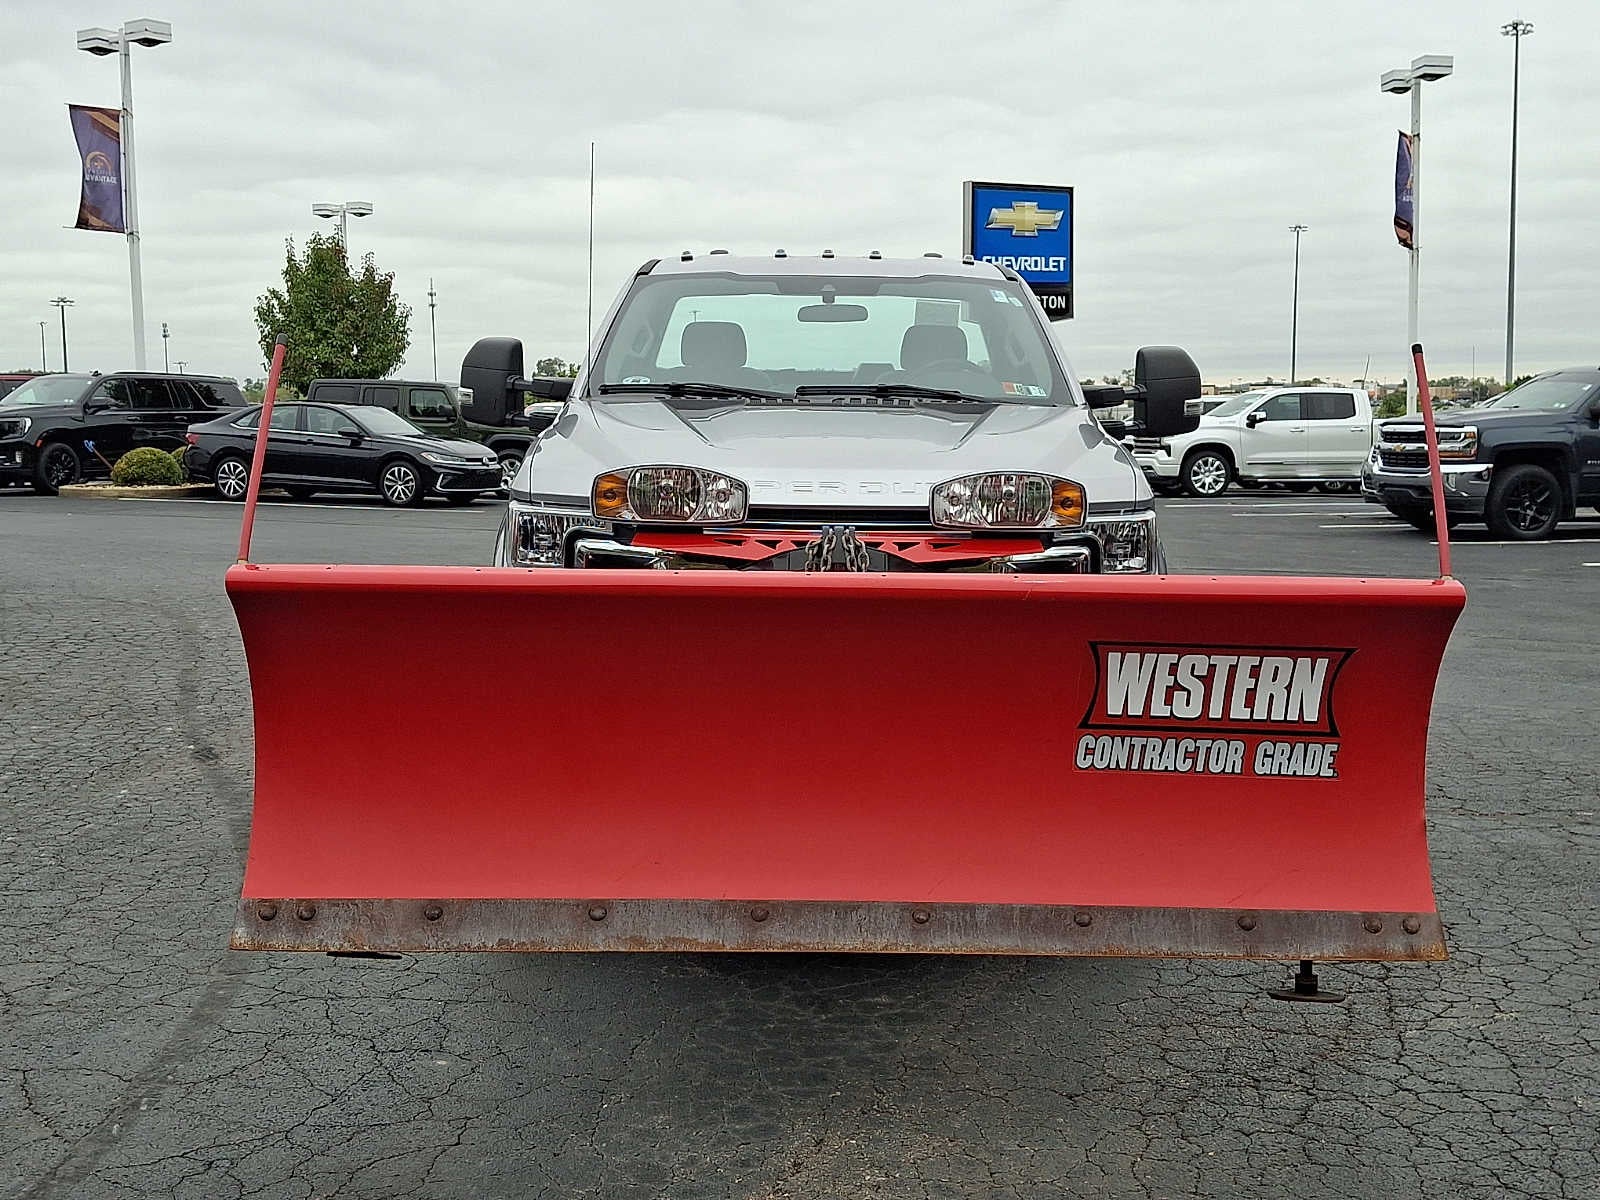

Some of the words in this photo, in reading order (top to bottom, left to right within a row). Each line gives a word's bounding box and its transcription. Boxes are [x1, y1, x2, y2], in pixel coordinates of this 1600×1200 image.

[1106, 651, 1330, 723] WESTERN
[1075, 734, 1246, 775] CONTRACTOR
[1253, 740, 1338, 778] GRADE
